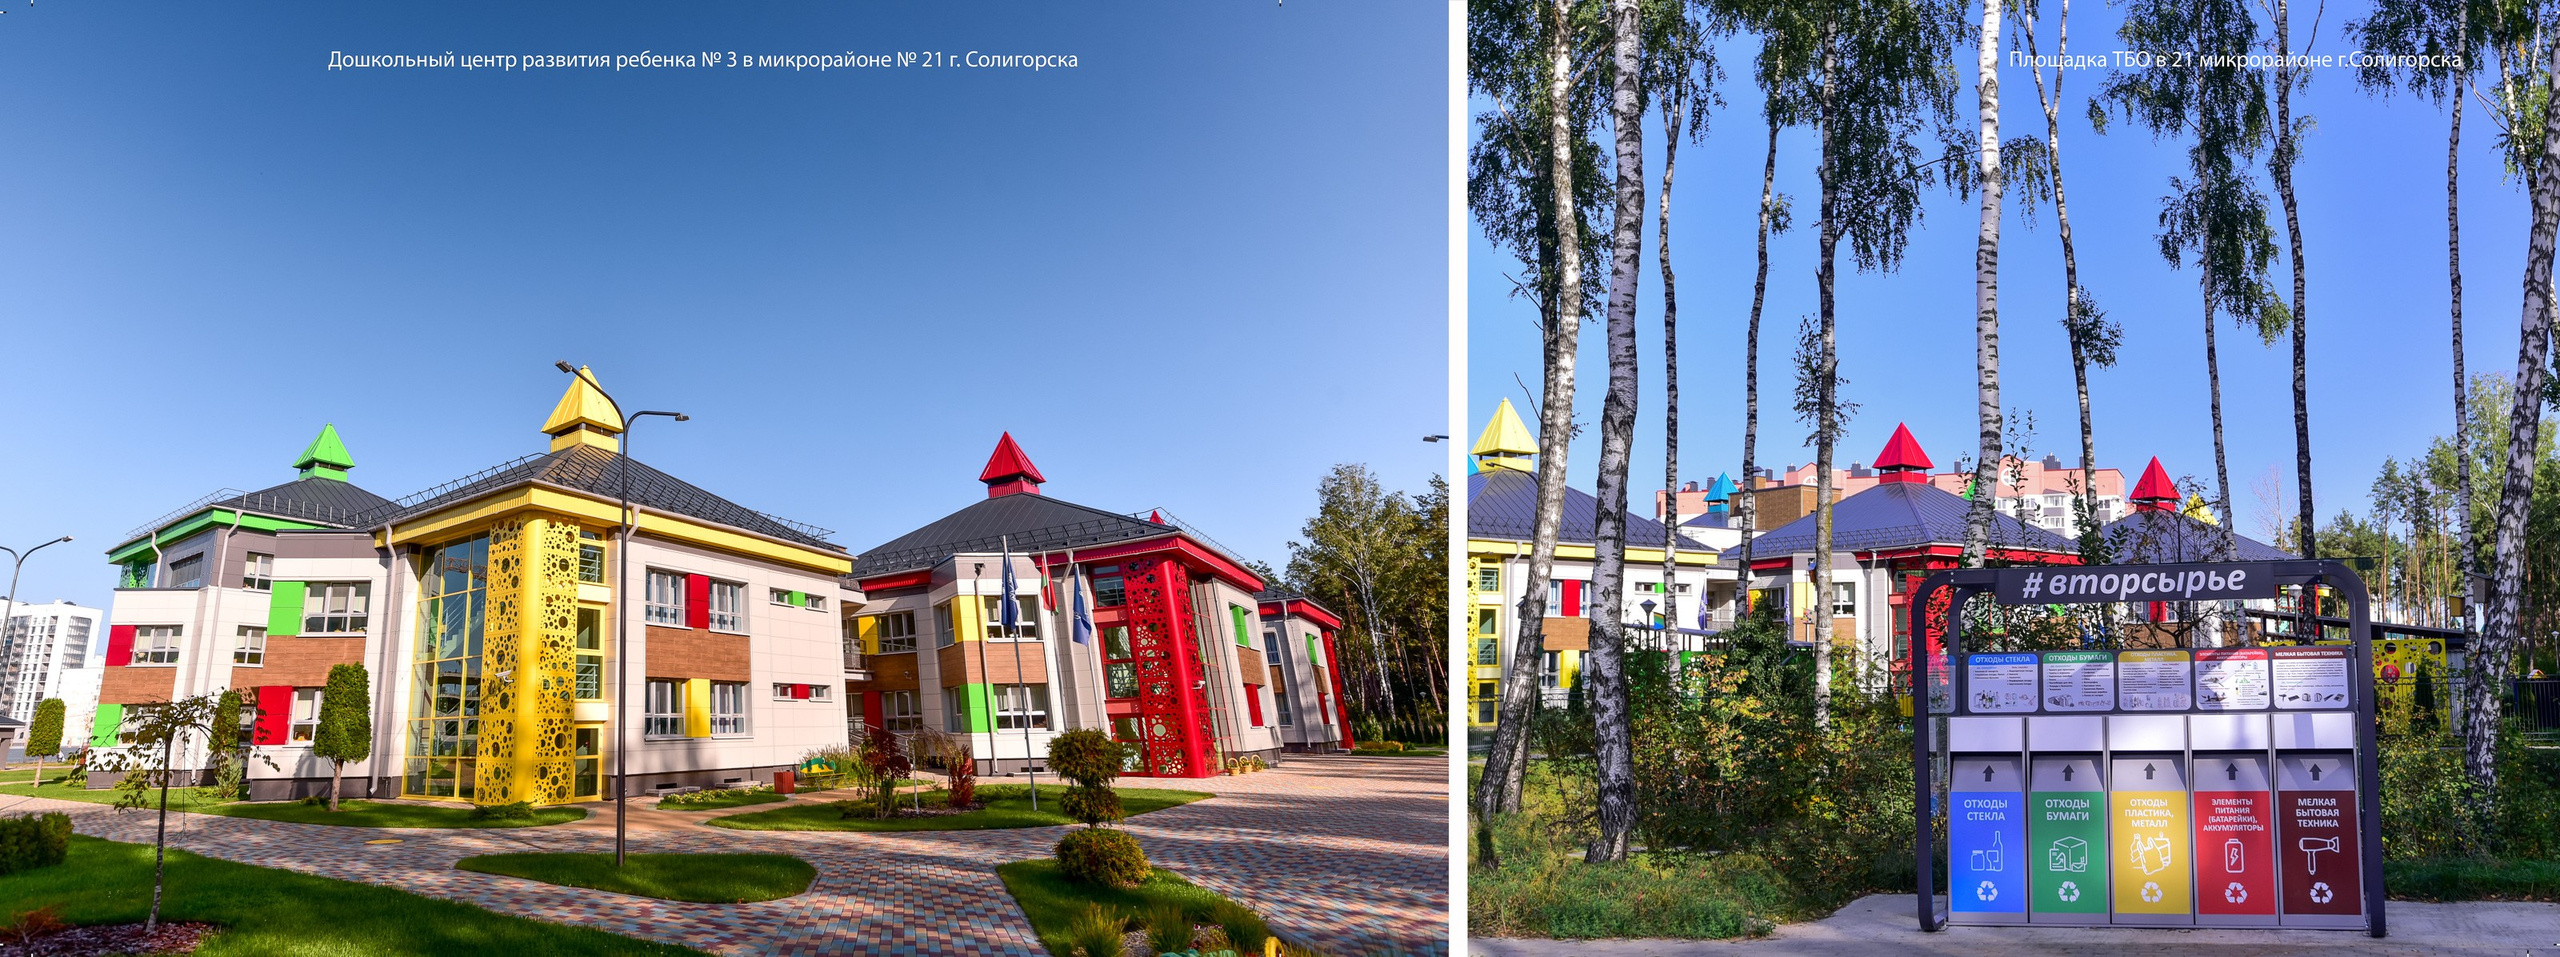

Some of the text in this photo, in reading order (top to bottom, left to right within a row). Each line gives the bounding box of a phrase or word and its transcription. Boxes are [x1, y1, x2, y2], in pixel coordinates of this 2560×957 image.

[2005, 655, 2030, 663] СТЕКЛА
[2048, 654, 2077, 662] ОТХОДЫ
[1964, 799, 2008, 809] ОТХОДЫ
[2045, 799, 2089, 809] ОТХОДЫ
[2130, 798, 2168, 808] ОТХОДЫ
[2211, 798, 2253, 806] ЭЛЕМЕНТЫ
[2297, 798, 2336, 807] МЕЛКАЯ
[1967, 811, 2006, 821] СТЕКЛА
[2046, 811, 2089, 821] БУМАГИ
[2124, 809, 2174, 818] ПЛАСТИКА,
[2295, 808, 2340, 817] БЫТОВАЯ
[2131, 819, 2168, 828] МЕТАЛЛ
[2203, 824, 2264, 832] АККУМУЛЯТОРЫ
[2297, 819, 2339, 828] ТЕХНИКА
